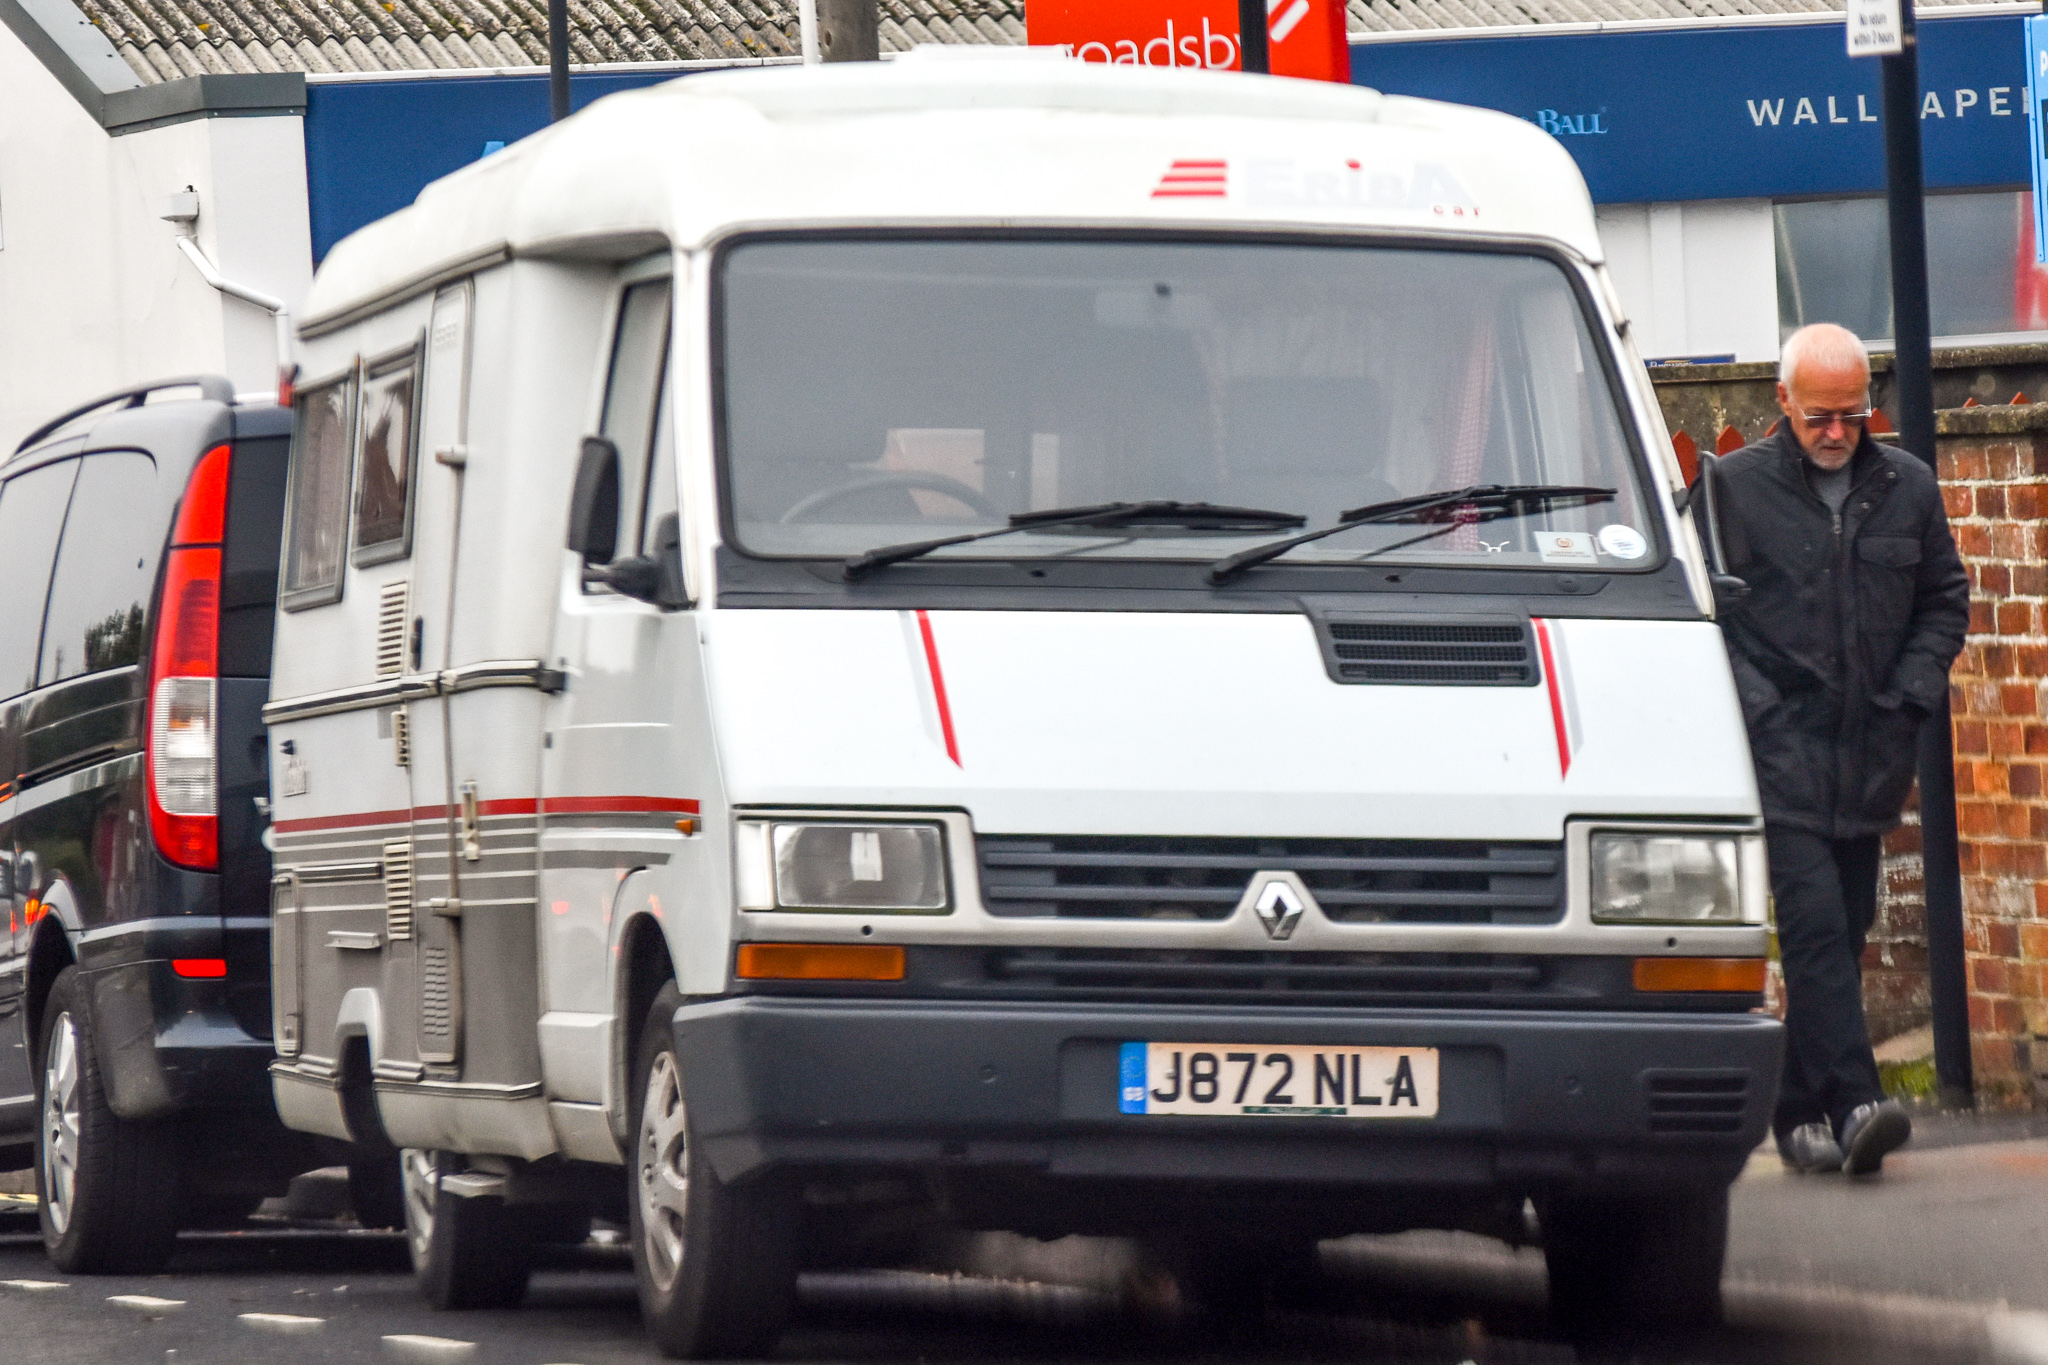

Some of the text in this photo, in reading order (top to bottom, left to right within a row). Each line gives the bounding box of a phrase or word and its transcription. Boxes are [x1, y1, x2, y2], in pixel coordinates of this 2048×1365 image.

[1063, 16, 1241, 69] oadsb
[1747, 86, 2029, 127] WALLAPE
[1151, 1052, 1419, 1107] J872 NLA
